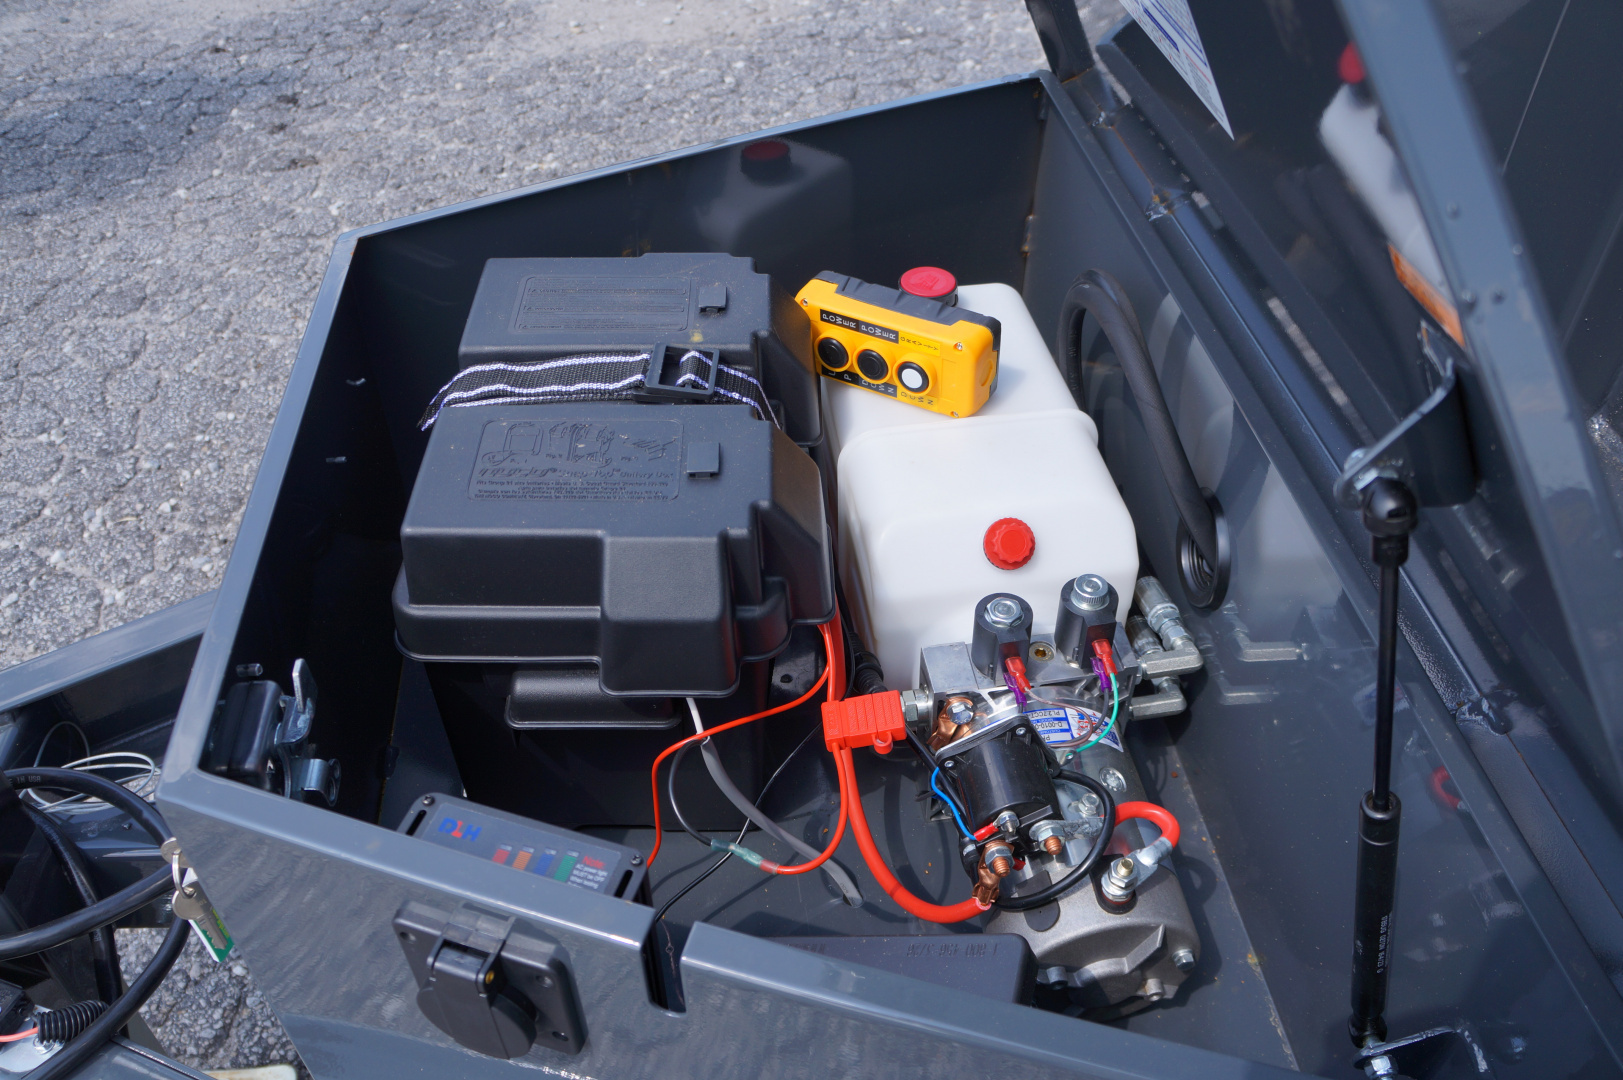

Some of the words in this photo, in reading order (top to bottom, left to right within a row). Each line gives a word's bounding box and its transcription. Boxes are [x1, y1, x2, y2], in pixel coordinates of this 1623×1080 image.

[822, 313, 856, 328] POWER
[861, 324, 896, 340] POWER
[900, 336, 939, 351] GRAVITY
[28, 775, 41, 783] USA
